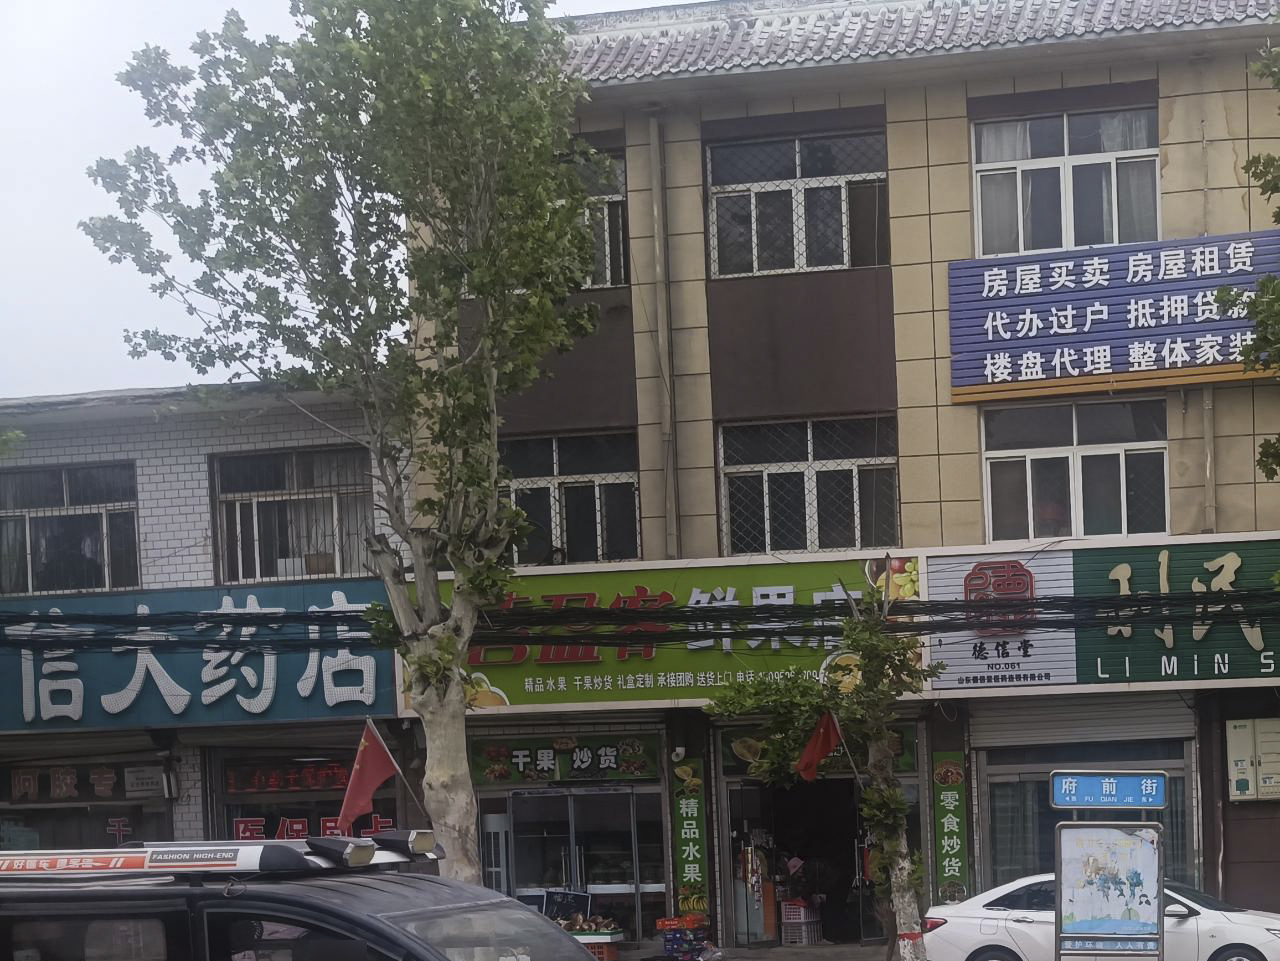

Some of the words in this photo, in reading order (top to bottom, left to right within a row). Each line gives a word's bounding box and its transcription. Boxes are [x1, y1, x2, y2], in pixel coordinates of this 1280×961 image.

[982, 254, 1110, 298] 房屋买卖
[1126, 241, 1256, 284] 房屋租赁
[983, 301, 1110, 341] 代办过户
[983, 344, 1113, 384] 楼盘代理
[1128, 331, 1257, 372] 整体家装
[524, 674, 568, 693] 精品水果
[573, 674, 613, 691] 干果炒货
[1097, 657, 1130, 678] LI
[512, 749, 555, 772] 干果
[573, 747, 618, 771] 炒货
[1061, 778, 1158, 795] 府前街
[679, 798, 703, 884] 精品水果
[940, 790, 962, 877] 零食炒货
[152, 852, 190, 861] FASHION
[193, 851, 234, 860] HIGH-END
